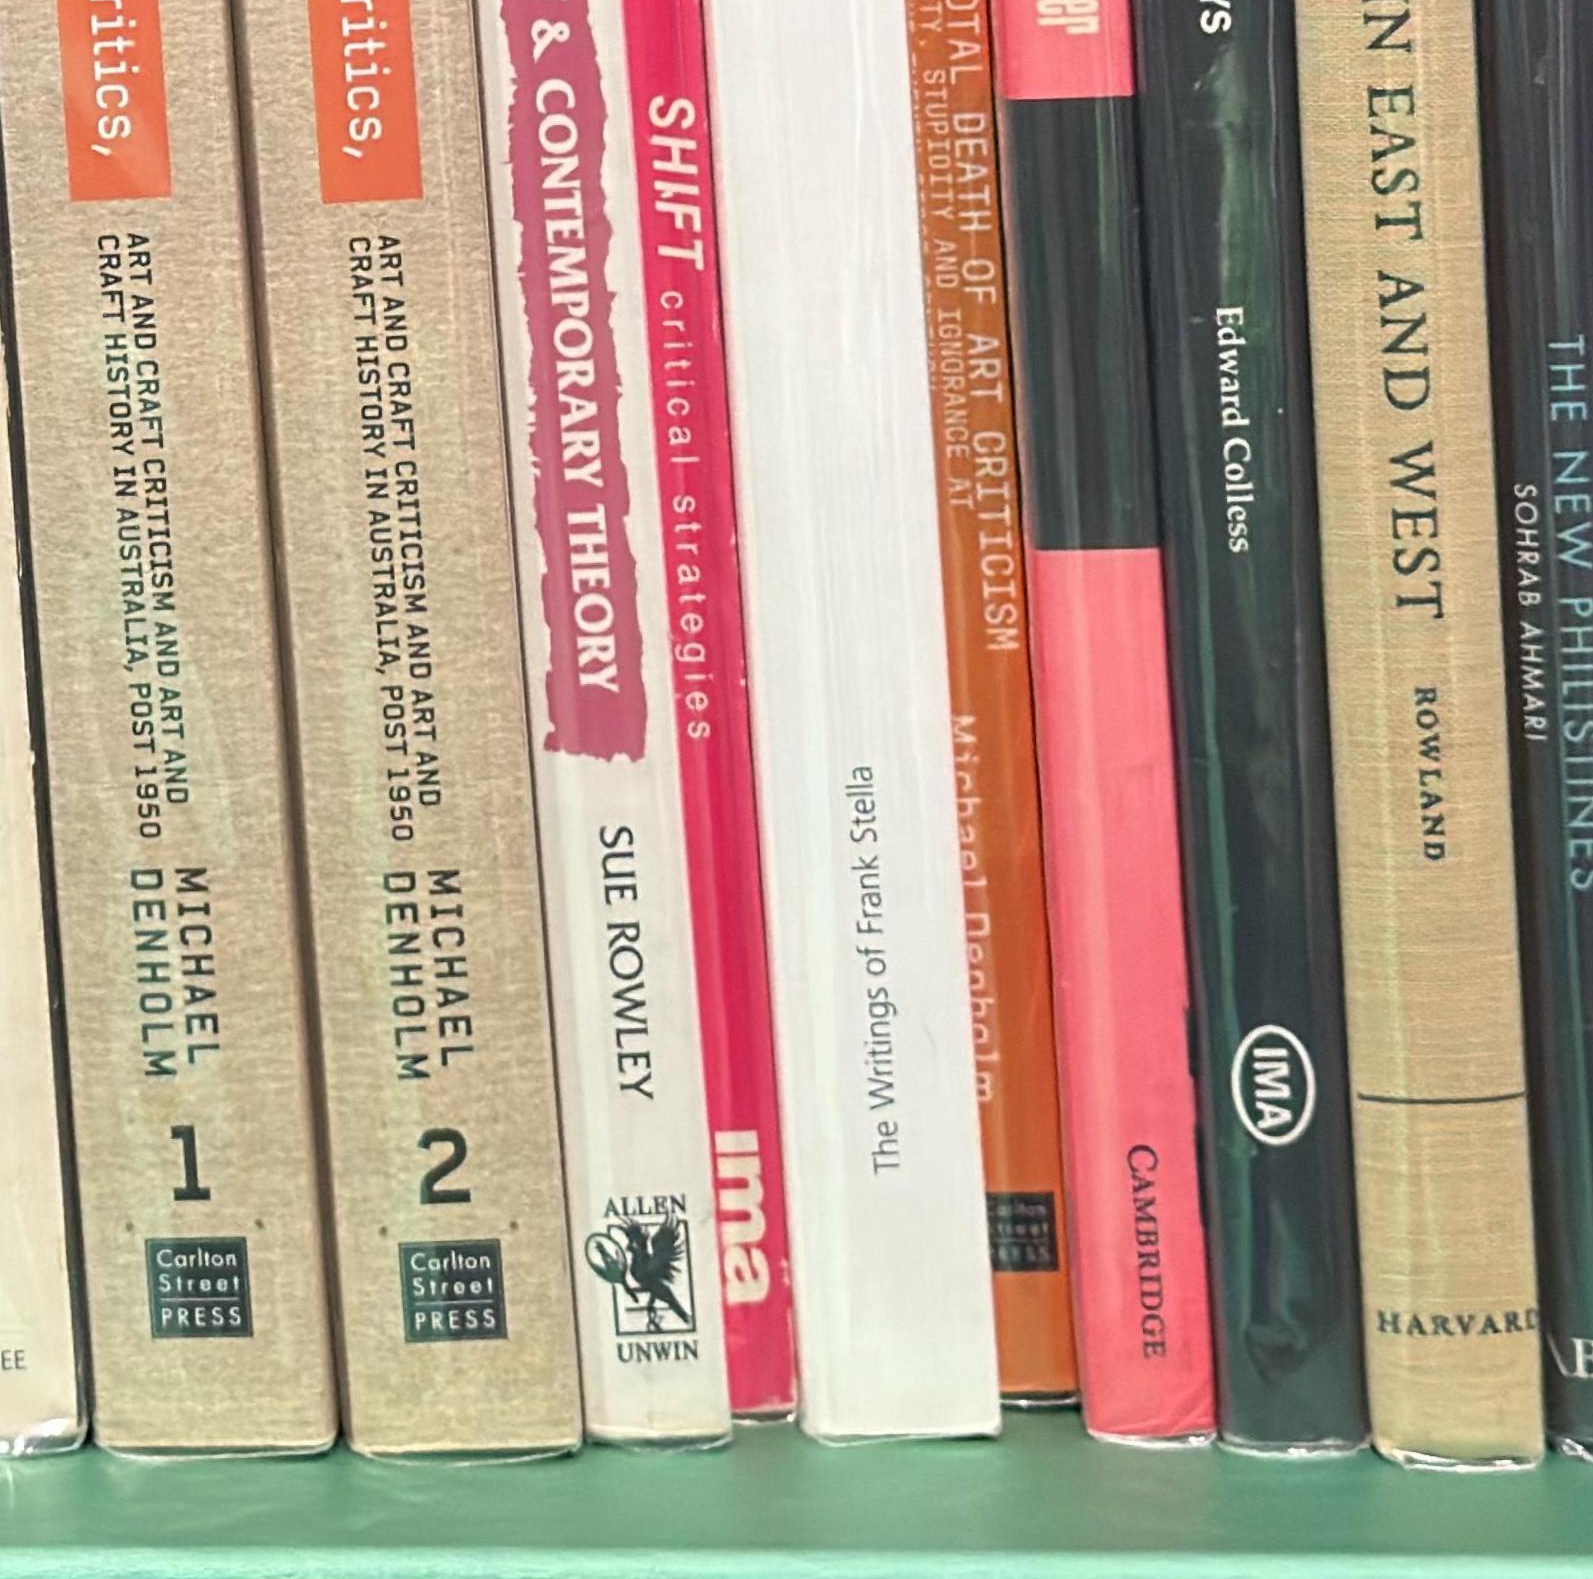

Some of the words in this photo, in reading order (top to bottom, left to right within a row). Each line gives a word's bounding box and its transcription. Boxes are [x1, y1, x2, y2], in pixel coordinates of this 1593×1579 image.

[530, 20, 570, 60] &
[650, 94, 703, 271] SHIFT
[955, 114, 990, 231] DEATH
[1365, 84, 1424, 245] EAST
[536, 76, 602, 488] CONTEMPORARY
[962, 259, 995, 304] OF
[662, 290, 701, 466] critical
[968, 335, 1001, 403] ART
[1214, 304, 1250, 426] Edward
[1378, 270, 1430, 414] AND
[1548, 334, 1586, 422] THE
[972, 431, 1019, 650] CRITICISM
[1220, 436, 1253, 554] Colless
[1385, 439, 1444, 621] WEST
[1513, 482, 1538, 612] SOHRAB
[1551, 450, 1593, 572] NEW
[567, 500, 619, 696] THEORY
[672, 494, 709, 742] strategies
[1519, 622, 1546, 742] AHMARI
[846, 764, 877, 852] Stella
[1414, 686, 1446, 862] ROWLAND
[599, 826, 636, 908] SUE
[852, 856, 884, 938] Frank
[606, 925, 653, 1101] ROWLEY
[857, 942, 889, 979] of
[865, 987, 896, 1111] Writings
[170, 1124, 211, 1201] 1
[418, 1128, 472, 1204] 2
[604, 1194, 686, 1217] ALLEN
[872, 1120, 900, 1175] The
[156, 1249, 237, 1270] Carlton
[158, 1273, 241, 1294] Street
[1126, 1143, 1166, 1360] CAMBRIDGE
[161, 1305, 242, 1328] PRESS
[617, 1341, 698, 1363] UNWIN
